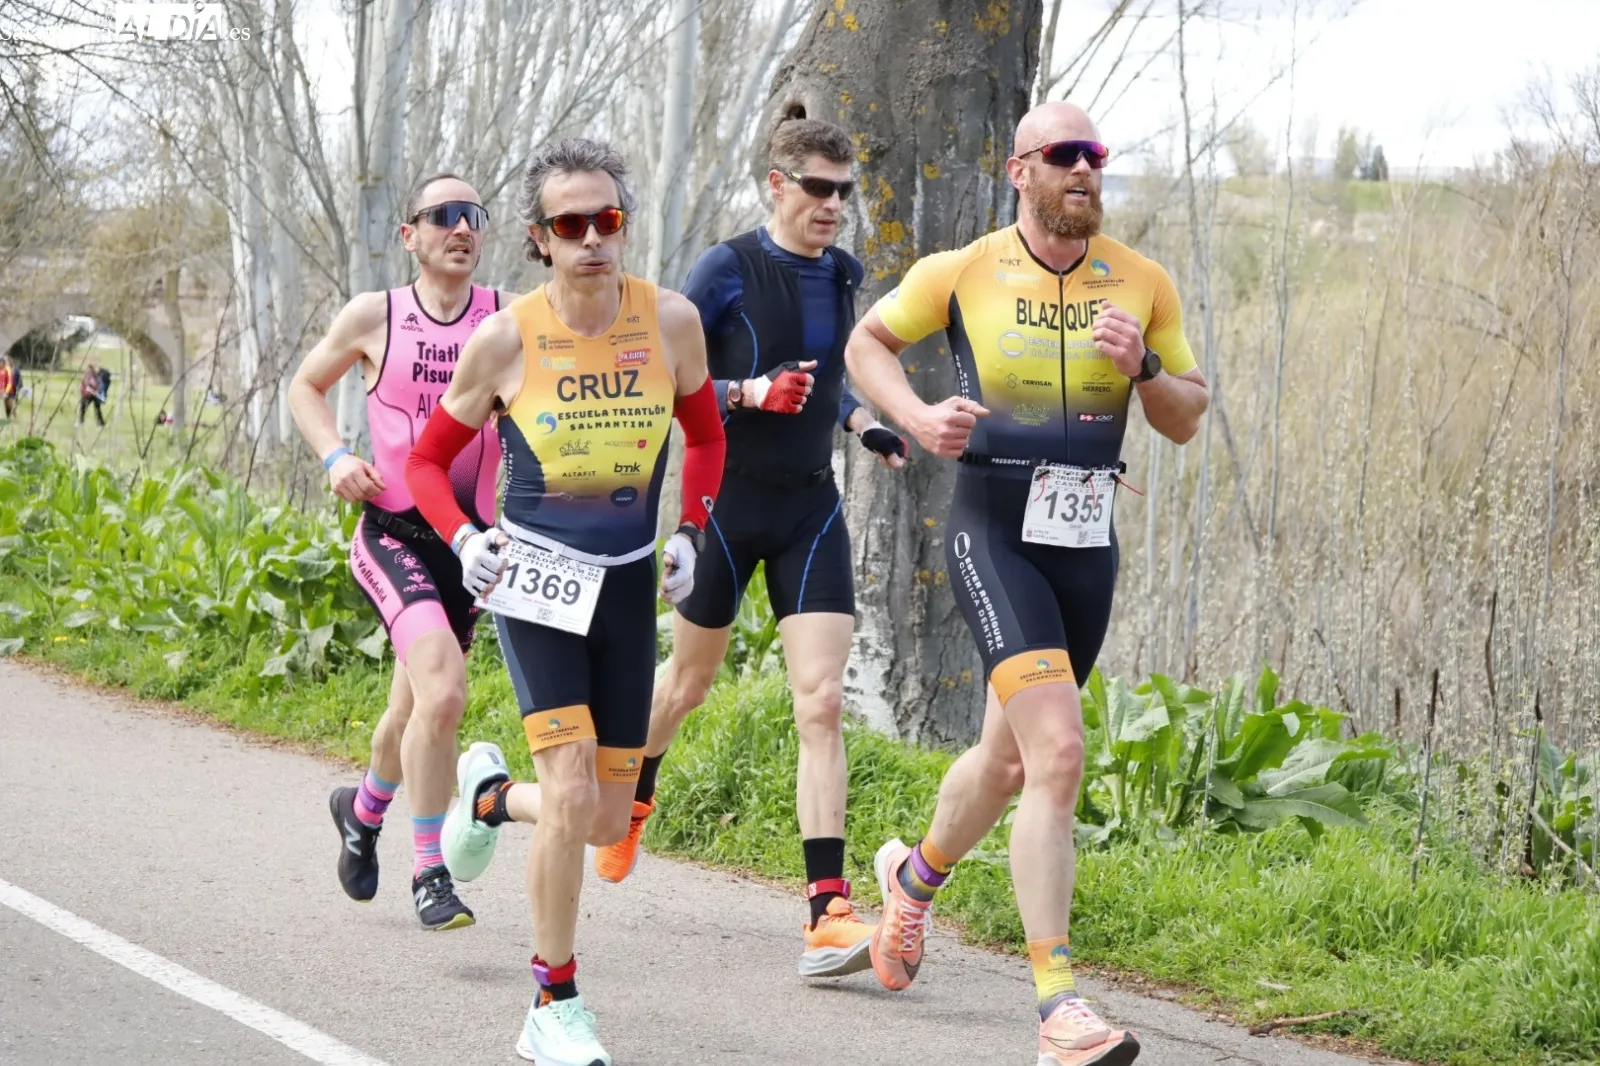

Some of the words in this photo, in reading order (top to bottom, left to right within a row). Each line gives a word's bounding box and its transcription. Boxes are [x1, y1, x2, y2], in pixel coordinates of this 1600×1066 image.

[1016, 297, 1108, 332] BLAZQUE
[416, 341, 460, 363] Triatl
[556, 369, 644, 403] CRUZ
[1022, 379, 1053, 387] CERVISAN
[1082, 385, 1112, 393] HERRERO
[557, 409, 610, 421] ESCUELA
[612, 404, 666, 418] TRIATLÓN
[569, 420, 653, 432] SALMANTINA
[562, 470, 597, 478] ALTAFIT
[613, 462, 642, 474] bmk
[1044, 490, 1104, 524] 1355
[357, 560, 388, 604] Valladolid
[506, 562, 581, 606] 1369
[959, 562, 980, 607] CLÍNICA
[978, 609, 994, 655] DENTAL
[965, 557, 983, 590] ESTER
[978, 590, 1005, 650] RODRÍGUEZ
